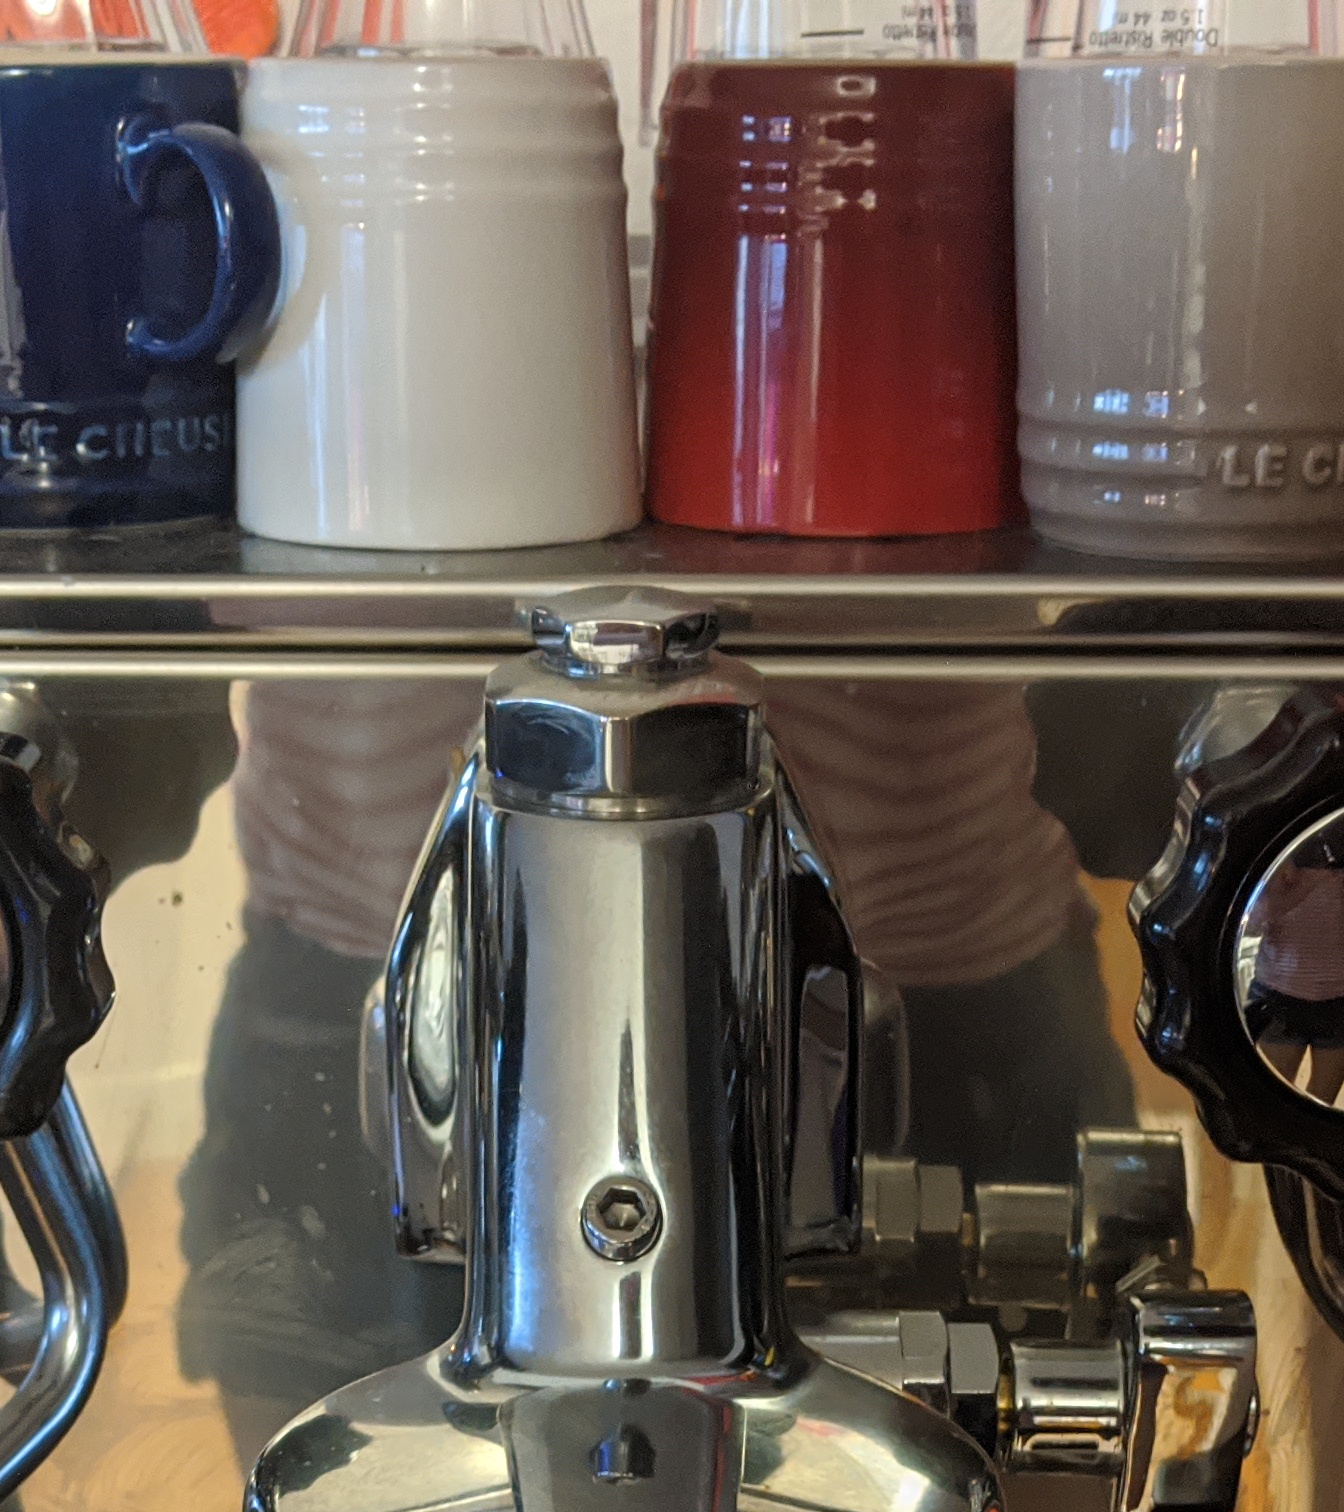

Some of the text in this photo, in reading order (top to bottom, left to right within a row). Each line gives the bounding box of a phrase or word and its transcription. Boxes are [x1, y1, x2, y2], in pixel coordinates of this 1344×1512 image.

[1089, 28, 1218, 49] Double Ristretto
[1219, 443, 1286, 487] LE
